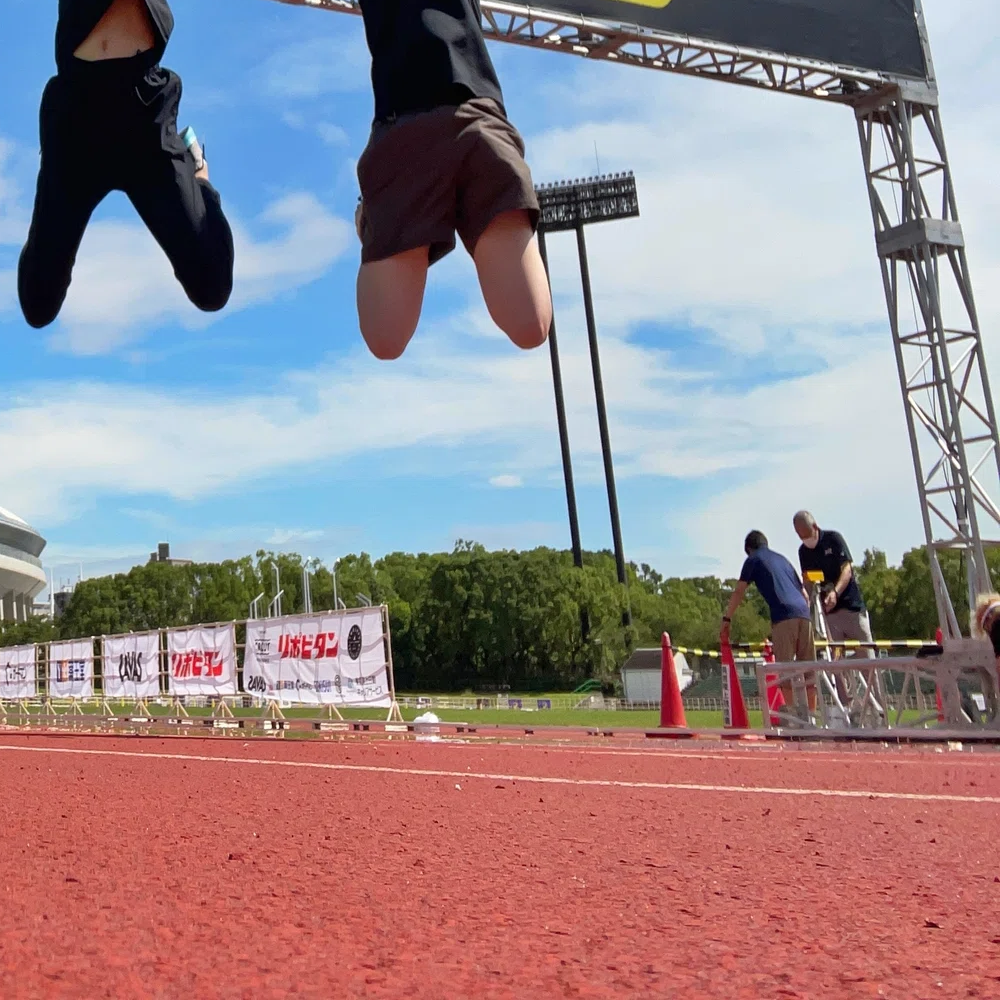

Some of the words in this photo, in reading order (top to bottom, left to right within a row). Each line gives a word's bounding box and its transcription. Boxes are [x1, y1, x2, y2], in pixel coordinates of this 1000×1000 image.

[278, 632, 338, 660] リポビタン
[172, 650, 223, 678] リポビタン
